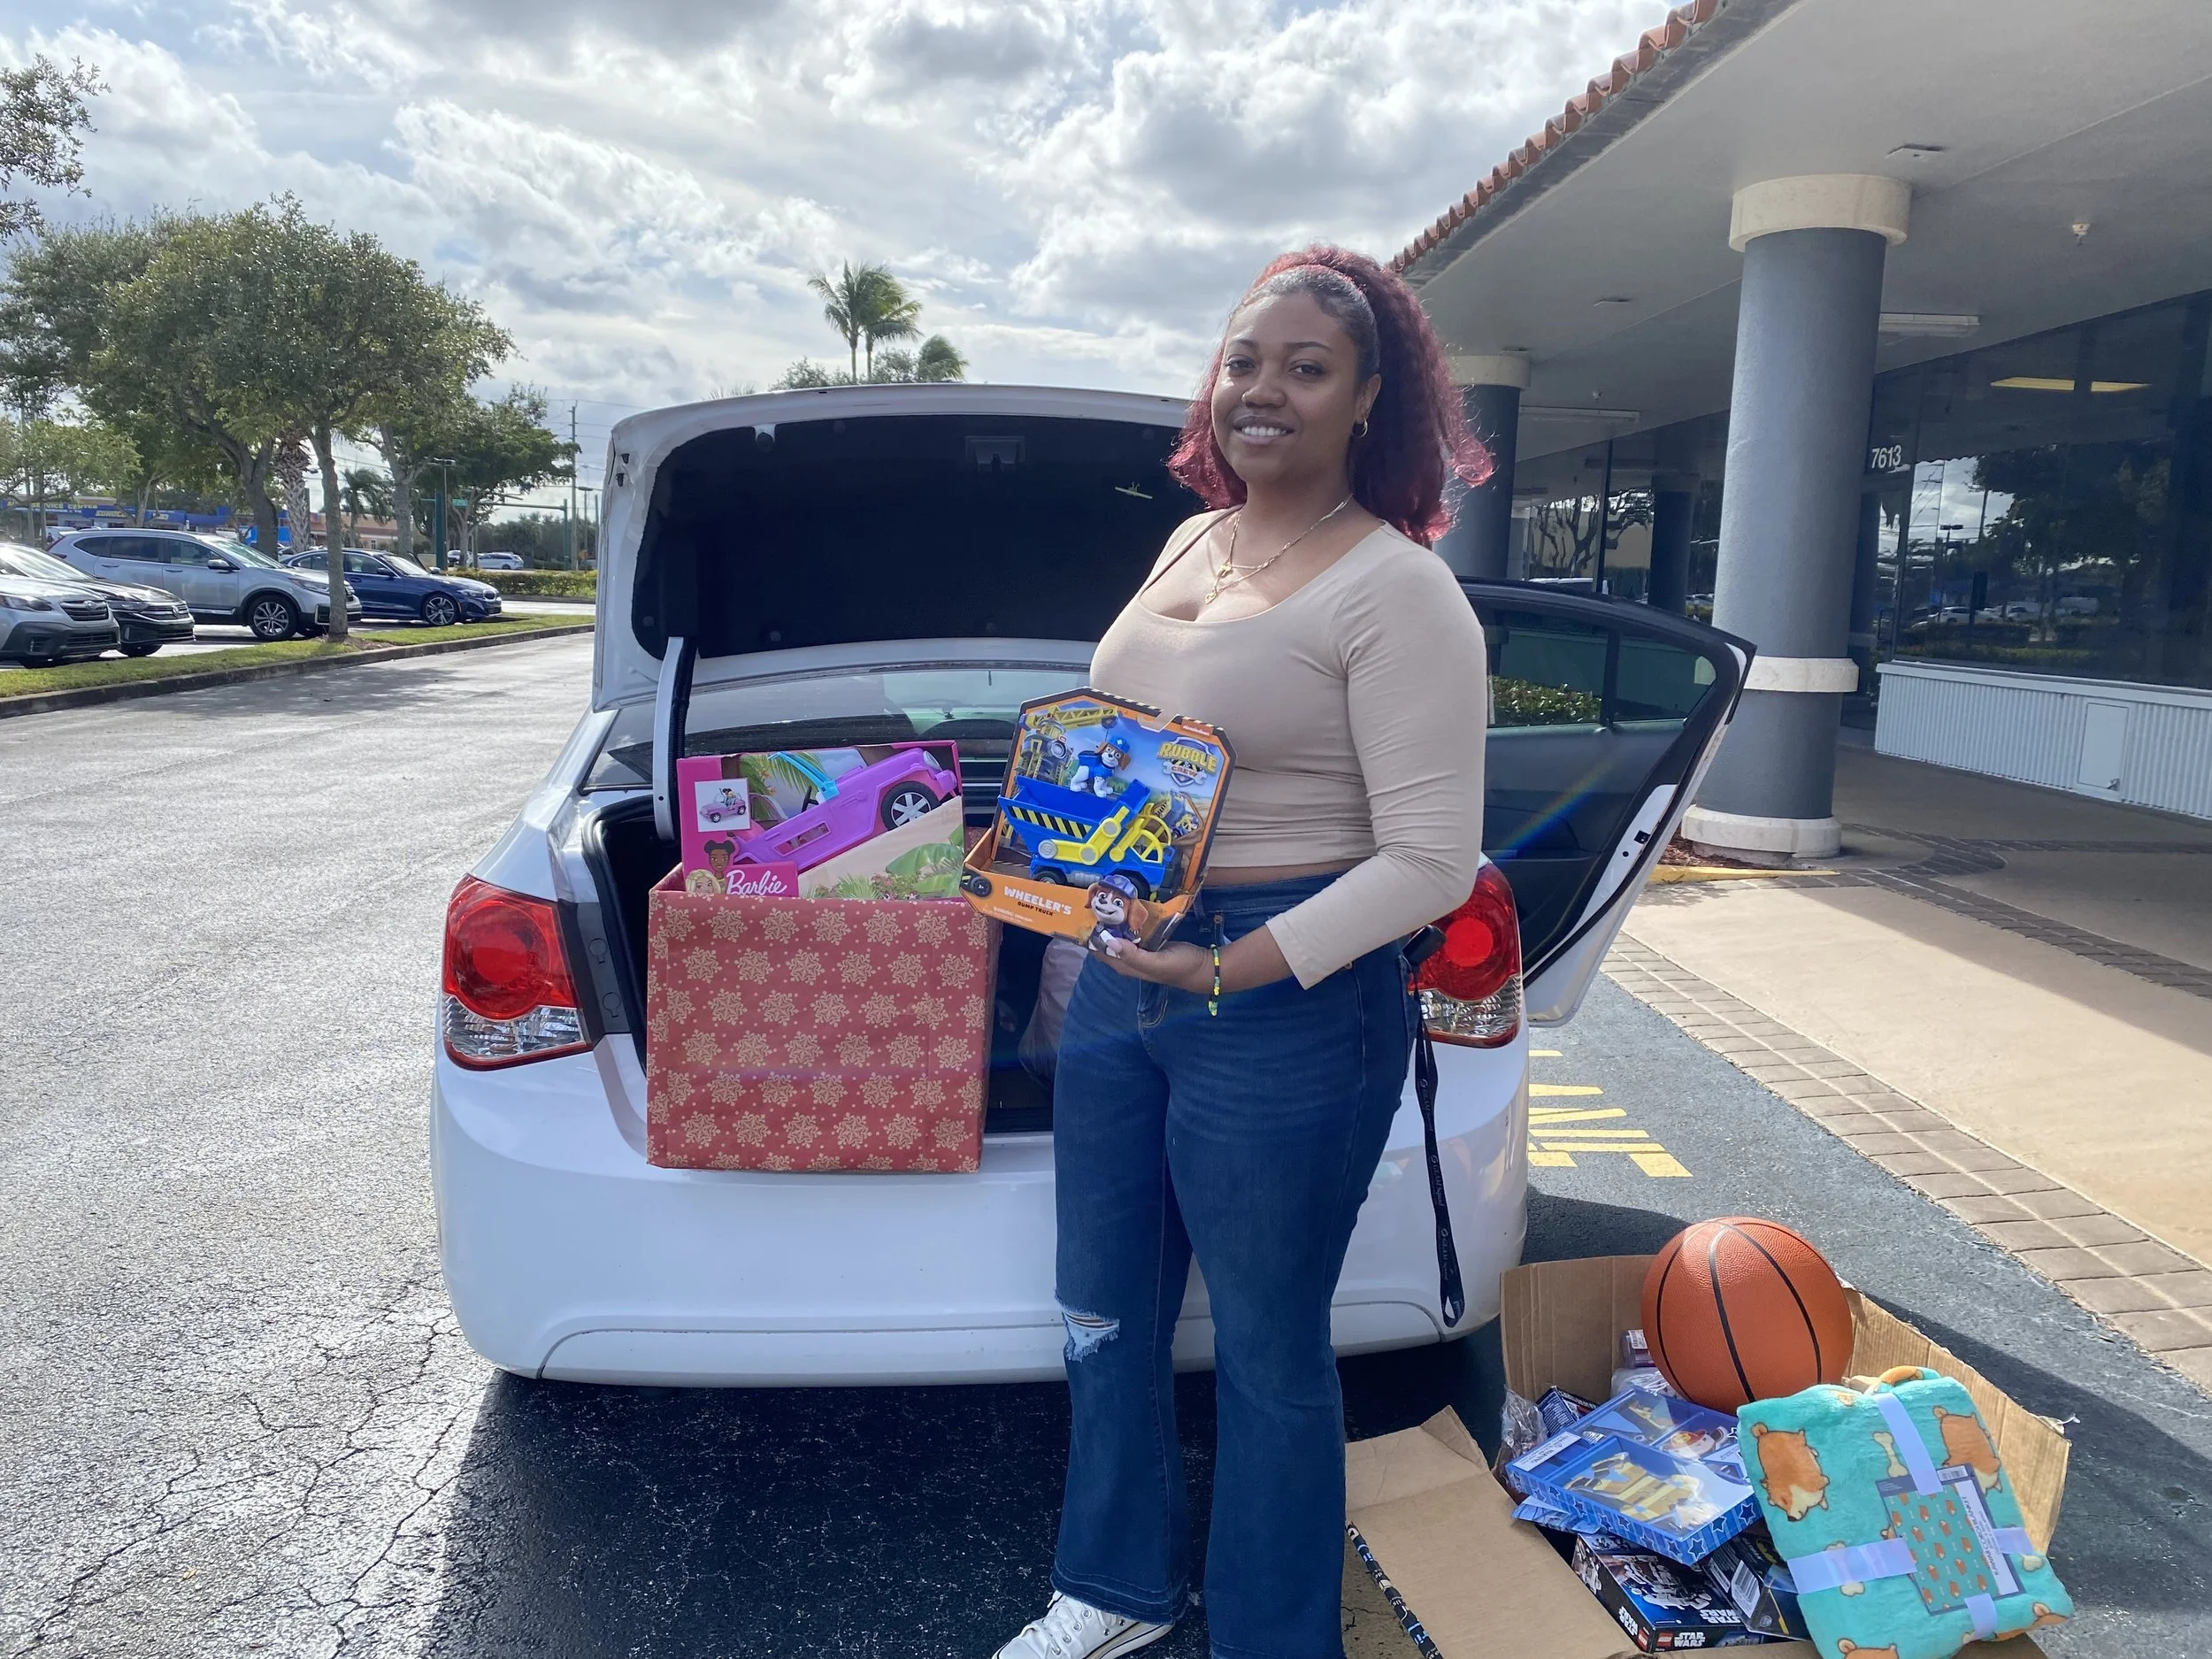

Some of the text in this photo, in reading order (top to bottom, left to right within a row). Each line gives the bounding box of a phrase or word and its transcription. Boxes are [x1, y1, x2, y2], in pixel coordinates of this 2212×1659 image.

[1871, 444, 1901, 469] 7613
[1158, 742, 1218, 772] RUBBLE
[1171, 764, 1198, 778] CREW
[726, 869, 787, 895] Barbie
[1003, 886, 1072, 916] WHEELER'S
[1017, 901, 1034, 911] DUMP
[1035, 905, 1055, 917] TRUCK
[1617, 1609, 1636, 1636] STAR
[1618, 1605, 1638, 1632] WARS
[1674, 1632, 1706, 1640] STAR
[1674, 1639, 1706, 1647] WARS
